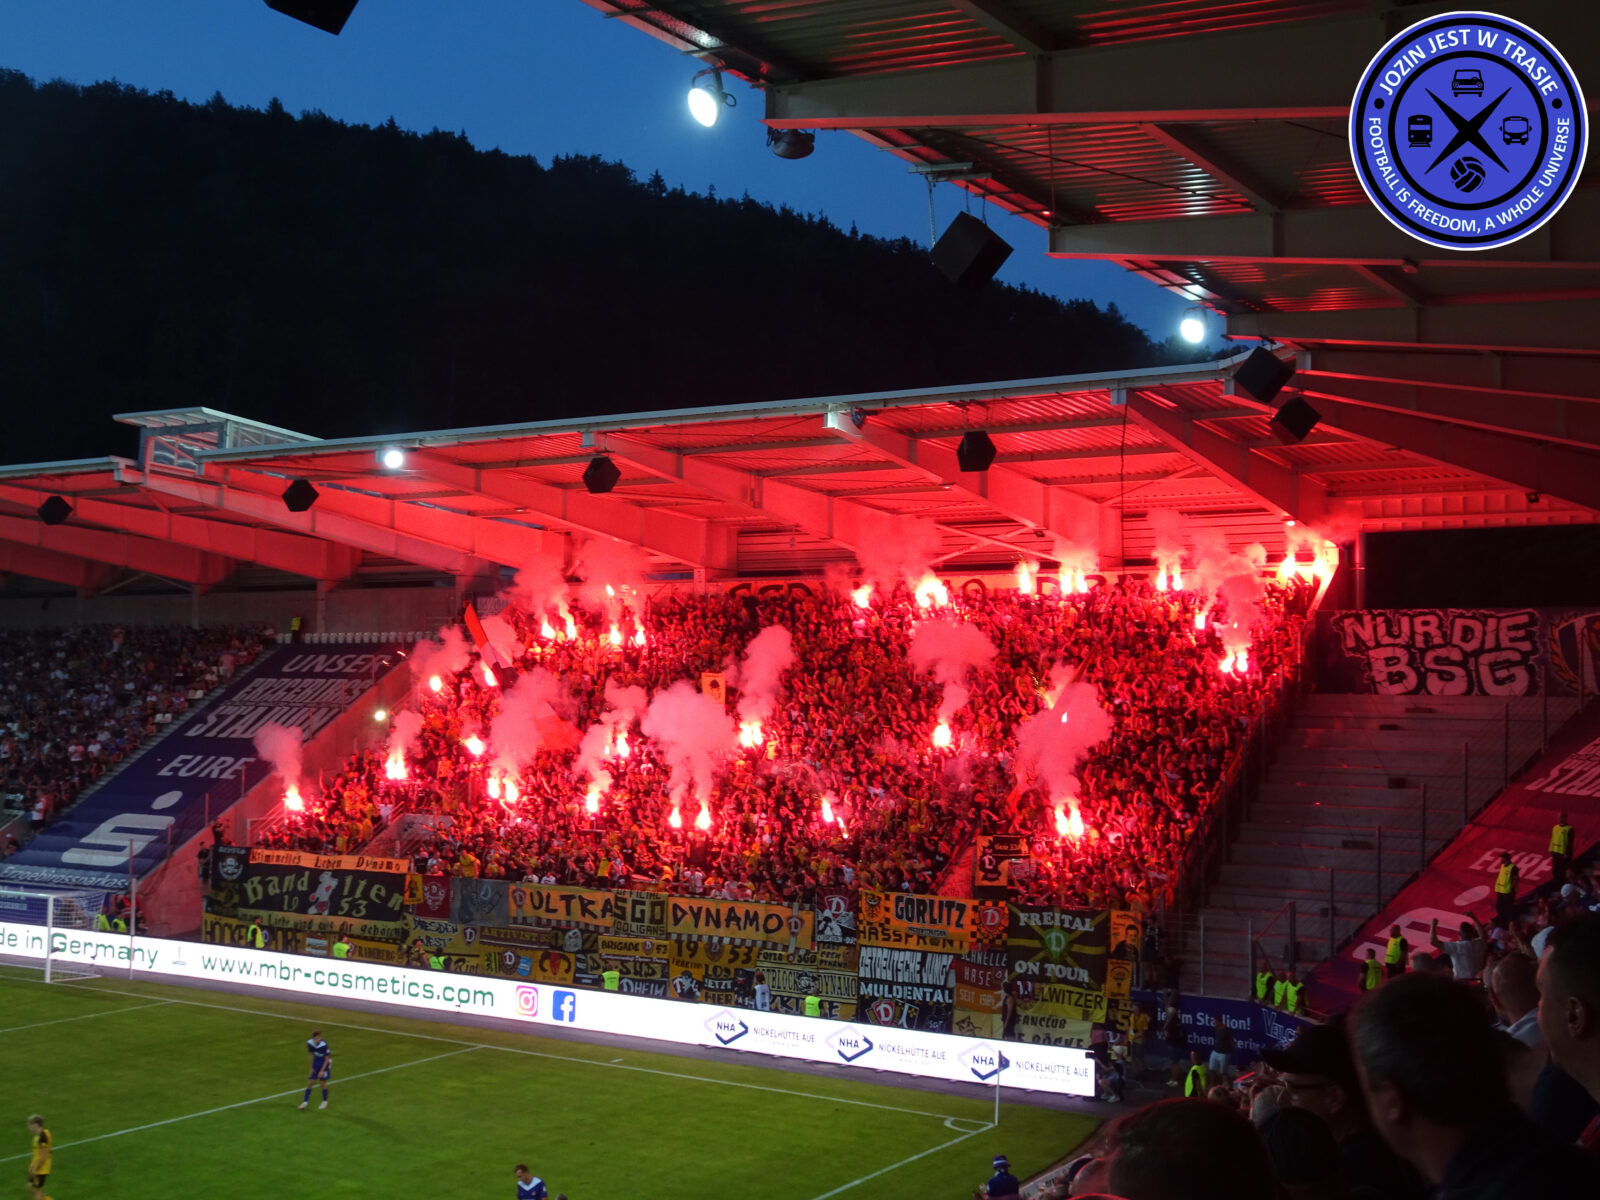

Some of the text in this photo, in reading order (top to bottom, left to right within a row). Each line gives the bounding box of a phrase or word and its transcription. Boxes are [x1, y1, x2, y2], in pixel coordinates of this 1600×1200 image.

[1343, 613, 1533, 653] NUR DIE
[281, 654, 392, 673] UNSER
[1368, 646, 1530, 698] BSG
[159, 754, 256, 780] EURE
[337, 897, 369, 918] 53
[671, 902, 784, 934] DYNAMO
[893, 894, 968, 930] GÖRLITZ
[1018, 911, 1095, 932] FREITAL
[26, 929, 43, 950] in
[51, 932, 159, 969] Germany
[673, 938, 754, 965] 19 53
[201, 954, 495, 1007] www.mbr-cosmetics.com
[1014, 960, 1089, 983] ON TOUR
[859, 981, 954, 1004] MULDENTAL
[716, 1020, 736, 1032] NHA
[801, 1033, 816, 1043] AUE
[839, 1036, 860, 1049] NHA
[933, 1050, 947, 1061] AUE
[972, 1054, 995, 1067] NHA
[1073, 1066, 1089, 1078] AUE
